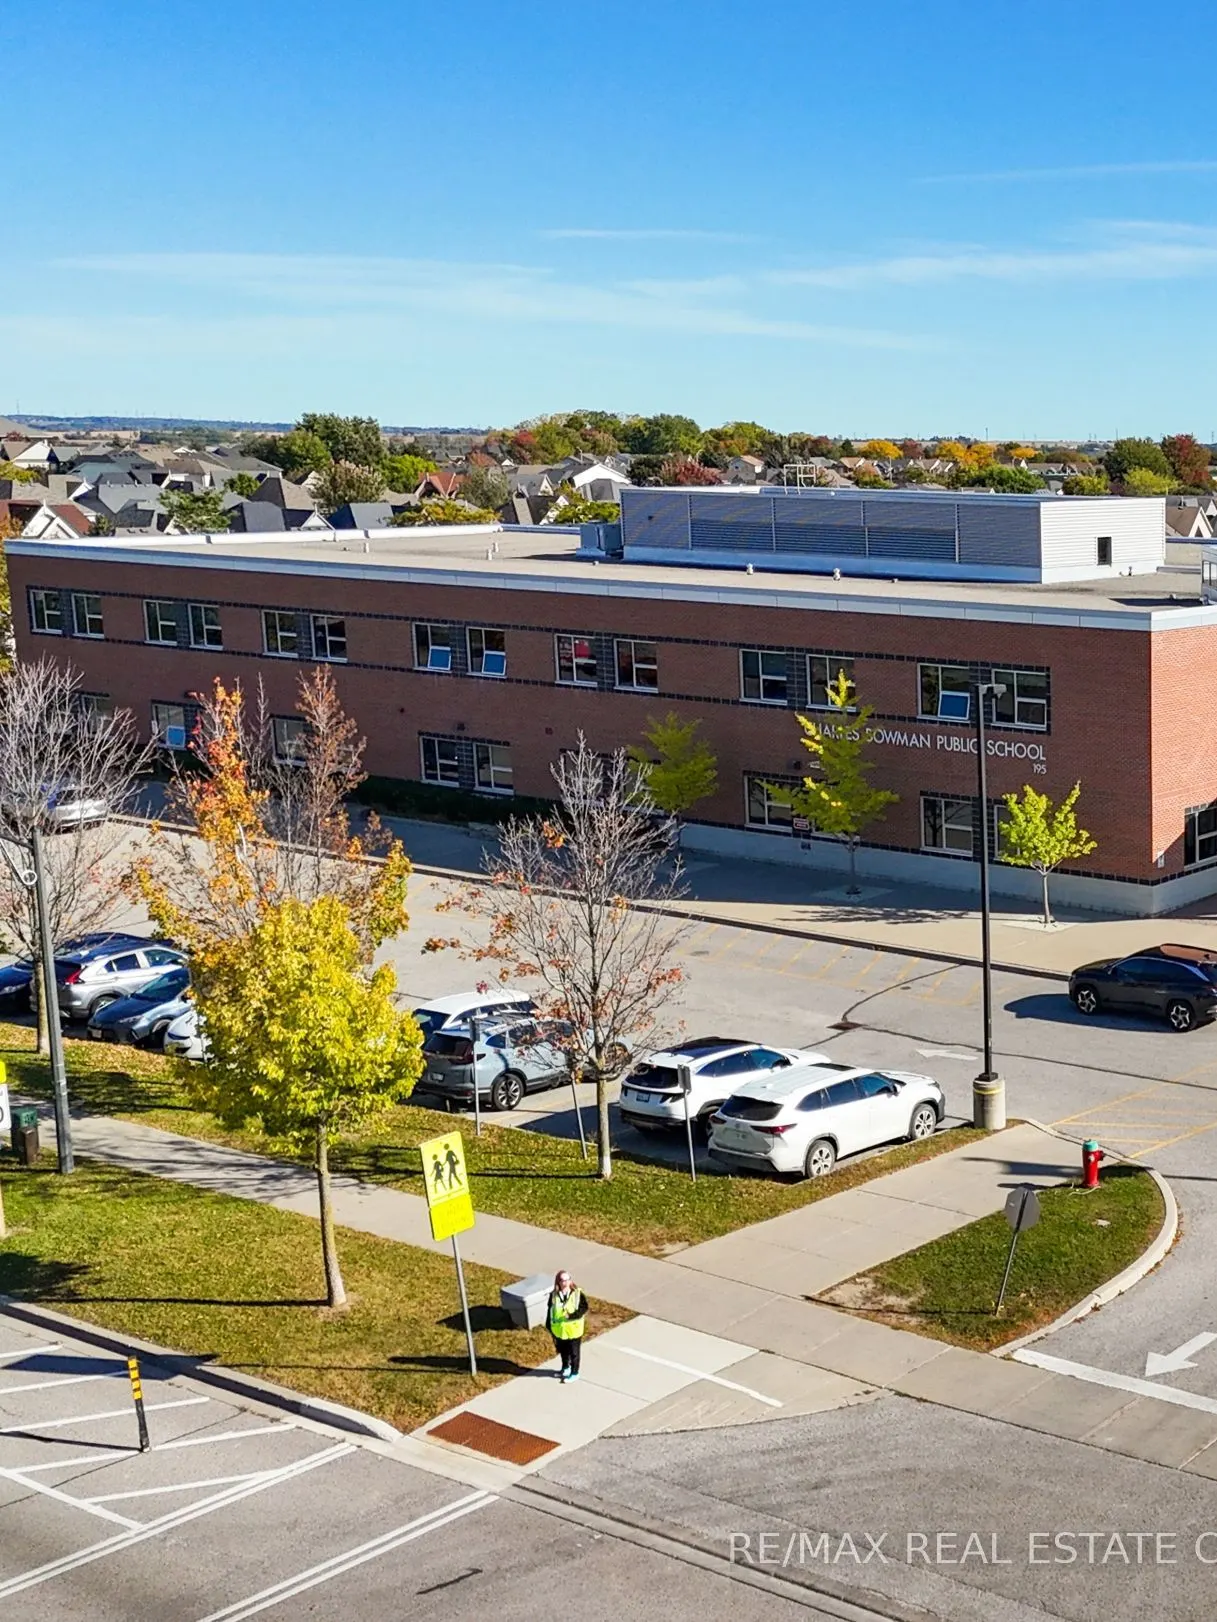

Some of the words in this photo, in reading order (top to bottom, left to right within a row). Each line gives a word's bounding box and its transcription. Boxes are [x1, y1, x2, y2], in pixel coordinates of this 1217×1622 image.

[804, 721, 860, 741] CHARES
[937, 735, 978, 754] PUBLIC
[986, 739, 1046, 761] SCHOOL
[1033, 763, 1047, 775] 195
